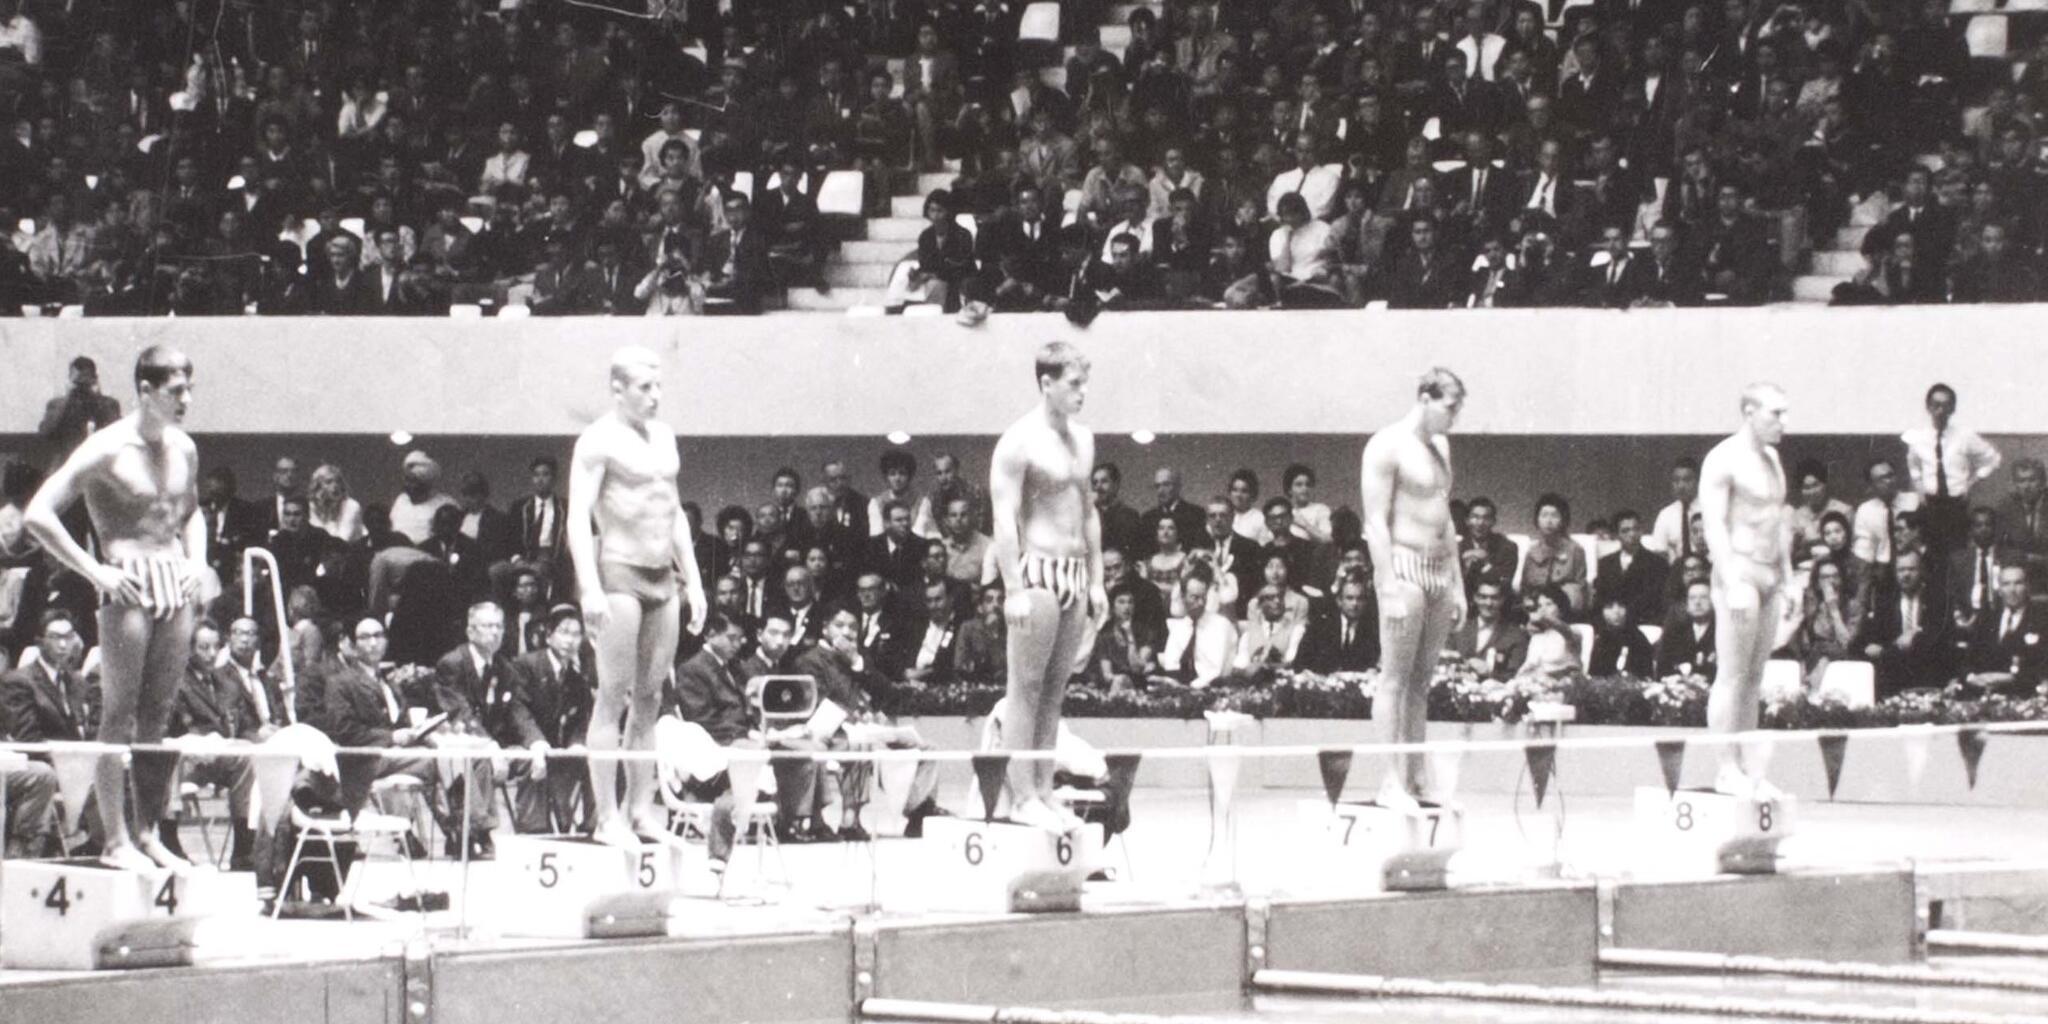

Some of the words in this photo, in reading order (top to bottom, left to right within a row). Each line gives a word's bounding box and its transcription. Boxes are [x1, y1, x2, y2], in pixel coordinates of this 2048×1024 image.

[1338, 814, 1358, 847] 7
[1426, 814, 1441, 847] 7
[1675, 800, 1695, 832] 8
[1758, 800, 1773, 832] 8
[964, 831, 985, 867] 6
[1055, 831, 1074, 867] 6
[538, 851, 559, 889] 5
[638, 851, 656, 889] 5
[44, 875, 71, 917] 4
[154, 874, 179, 916] 4
